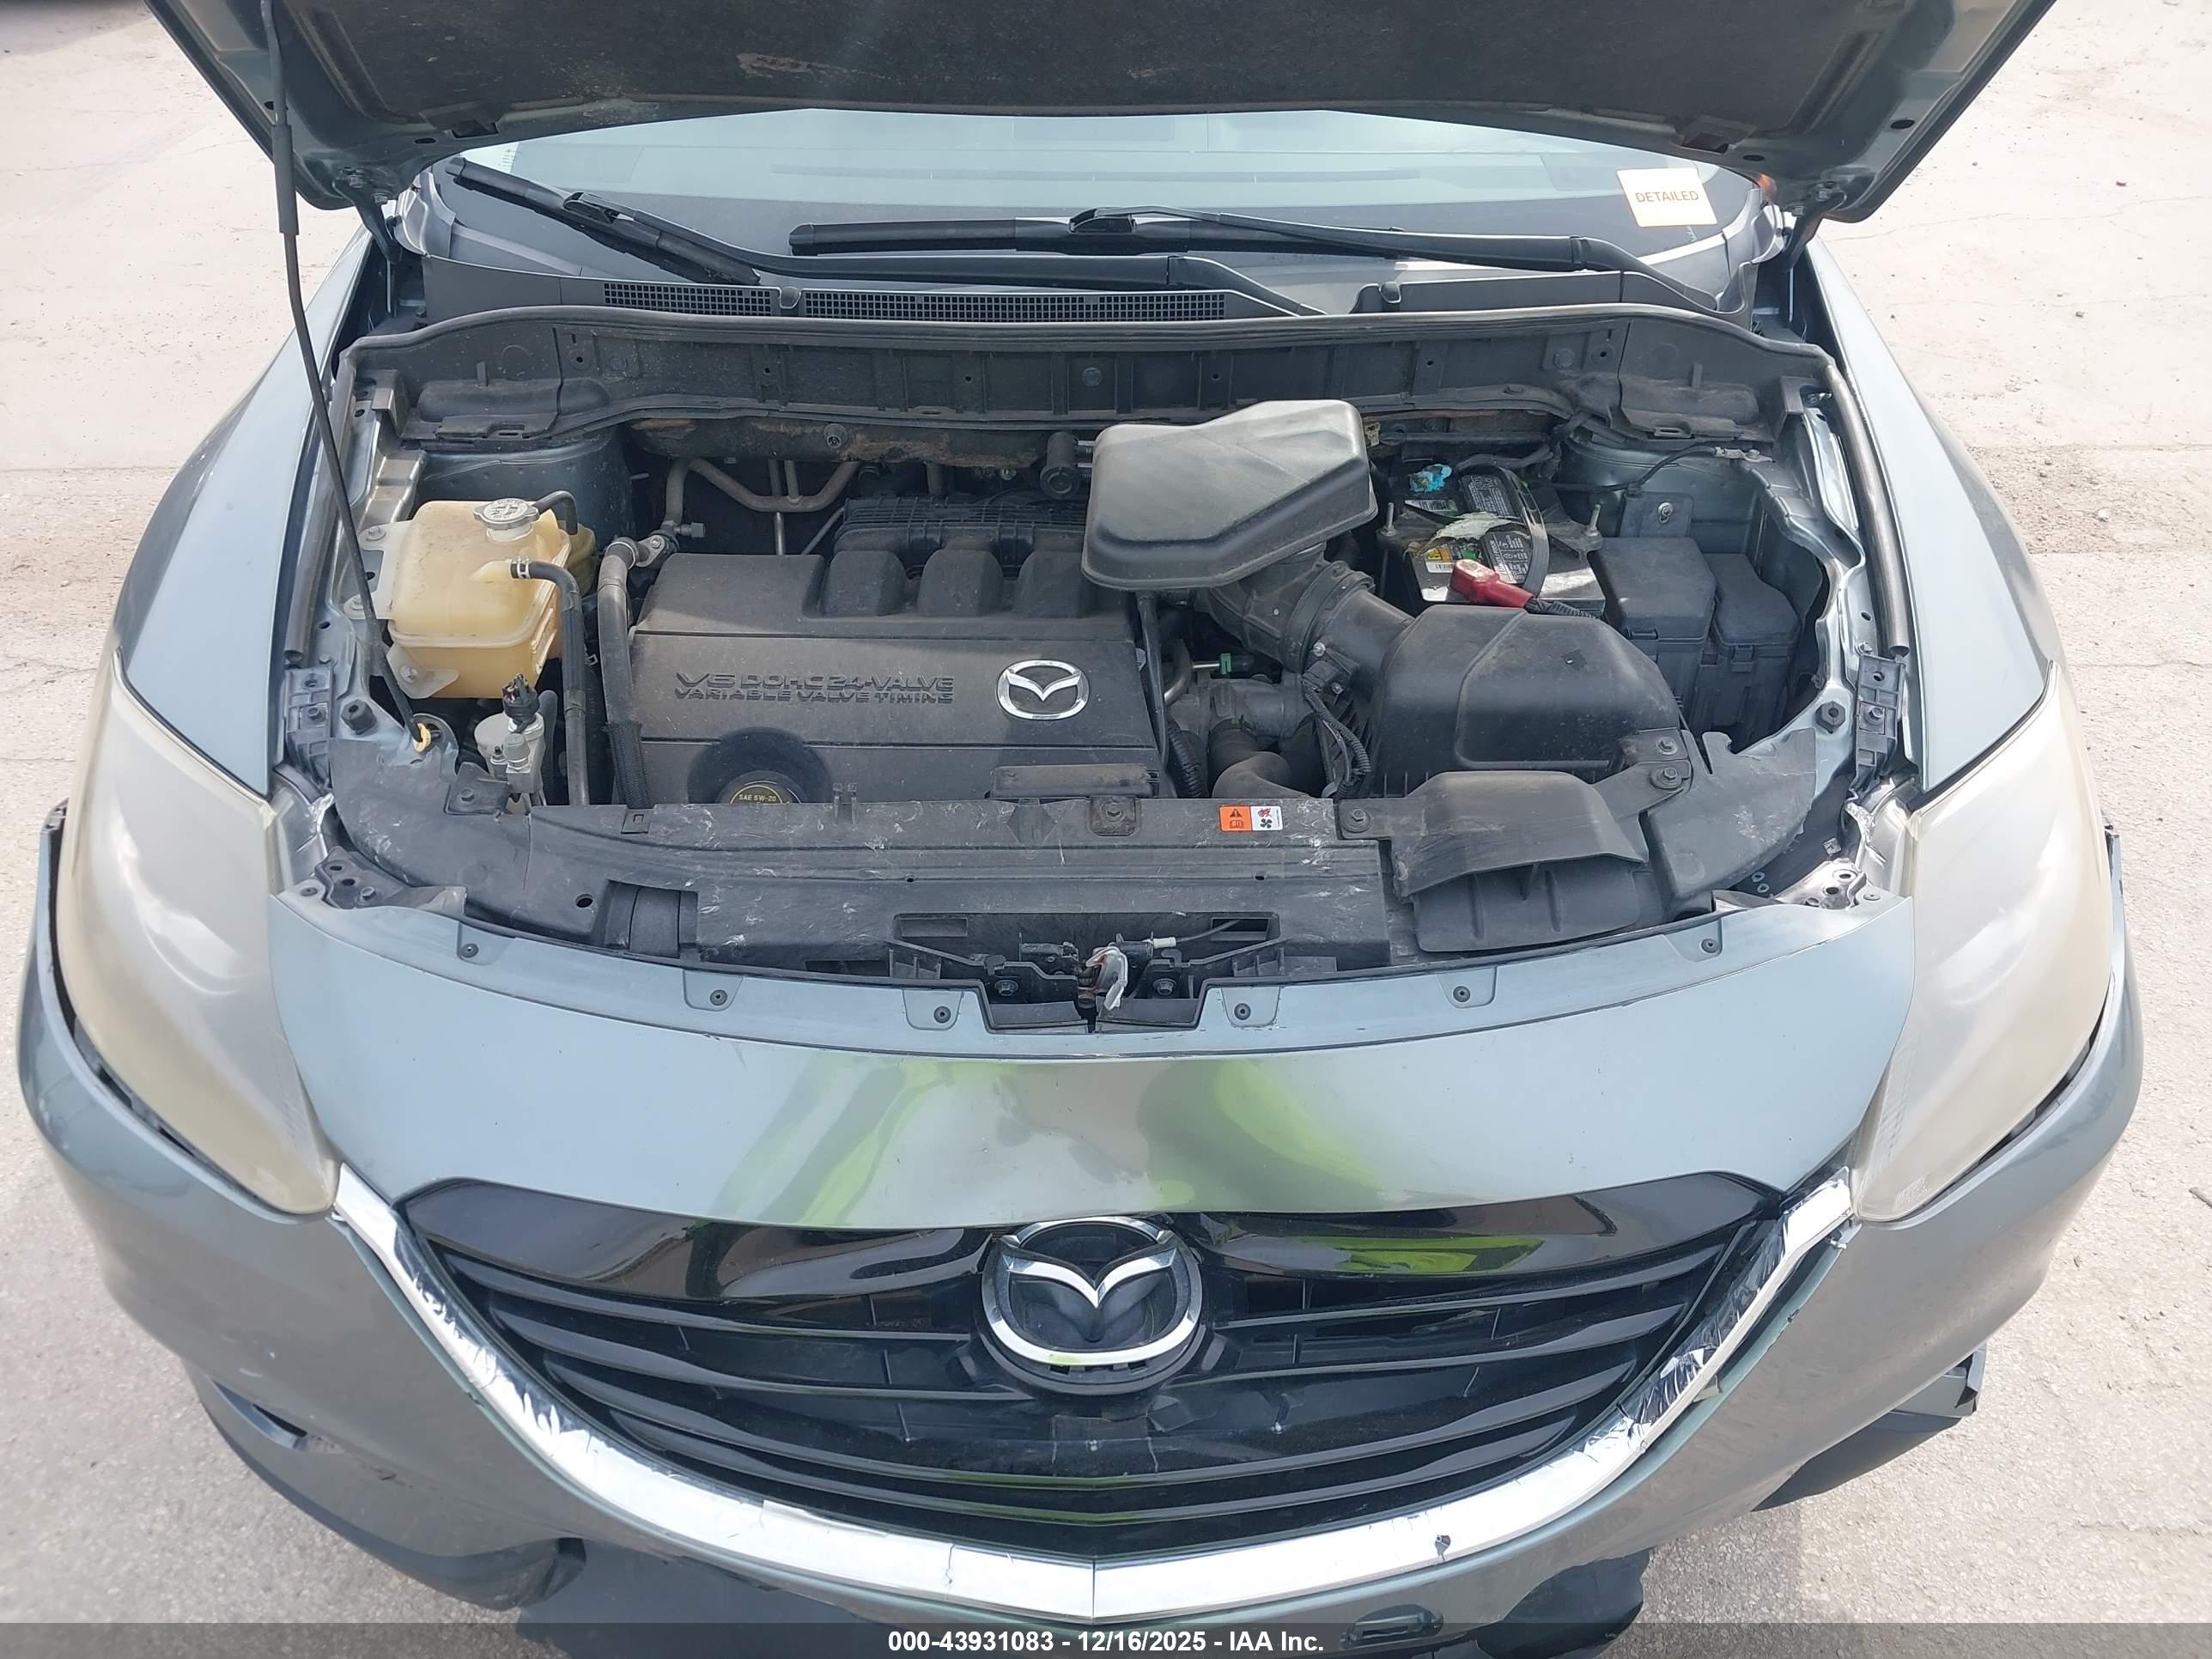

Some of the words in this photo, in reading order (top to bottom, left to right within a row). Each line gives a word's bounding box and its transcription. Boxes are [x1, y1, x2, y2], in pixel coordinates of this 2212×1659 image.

[1635, 191, 1698, 203] DETAILED
[740, 673, 823, 690] DOHC
[826, 676, 954, 692] 24-VALVE
[674, 688, 792, 702] VARIABLE
[797, 690, 870, 703] VALVE
[874, 692, 953, 704] TIMING
